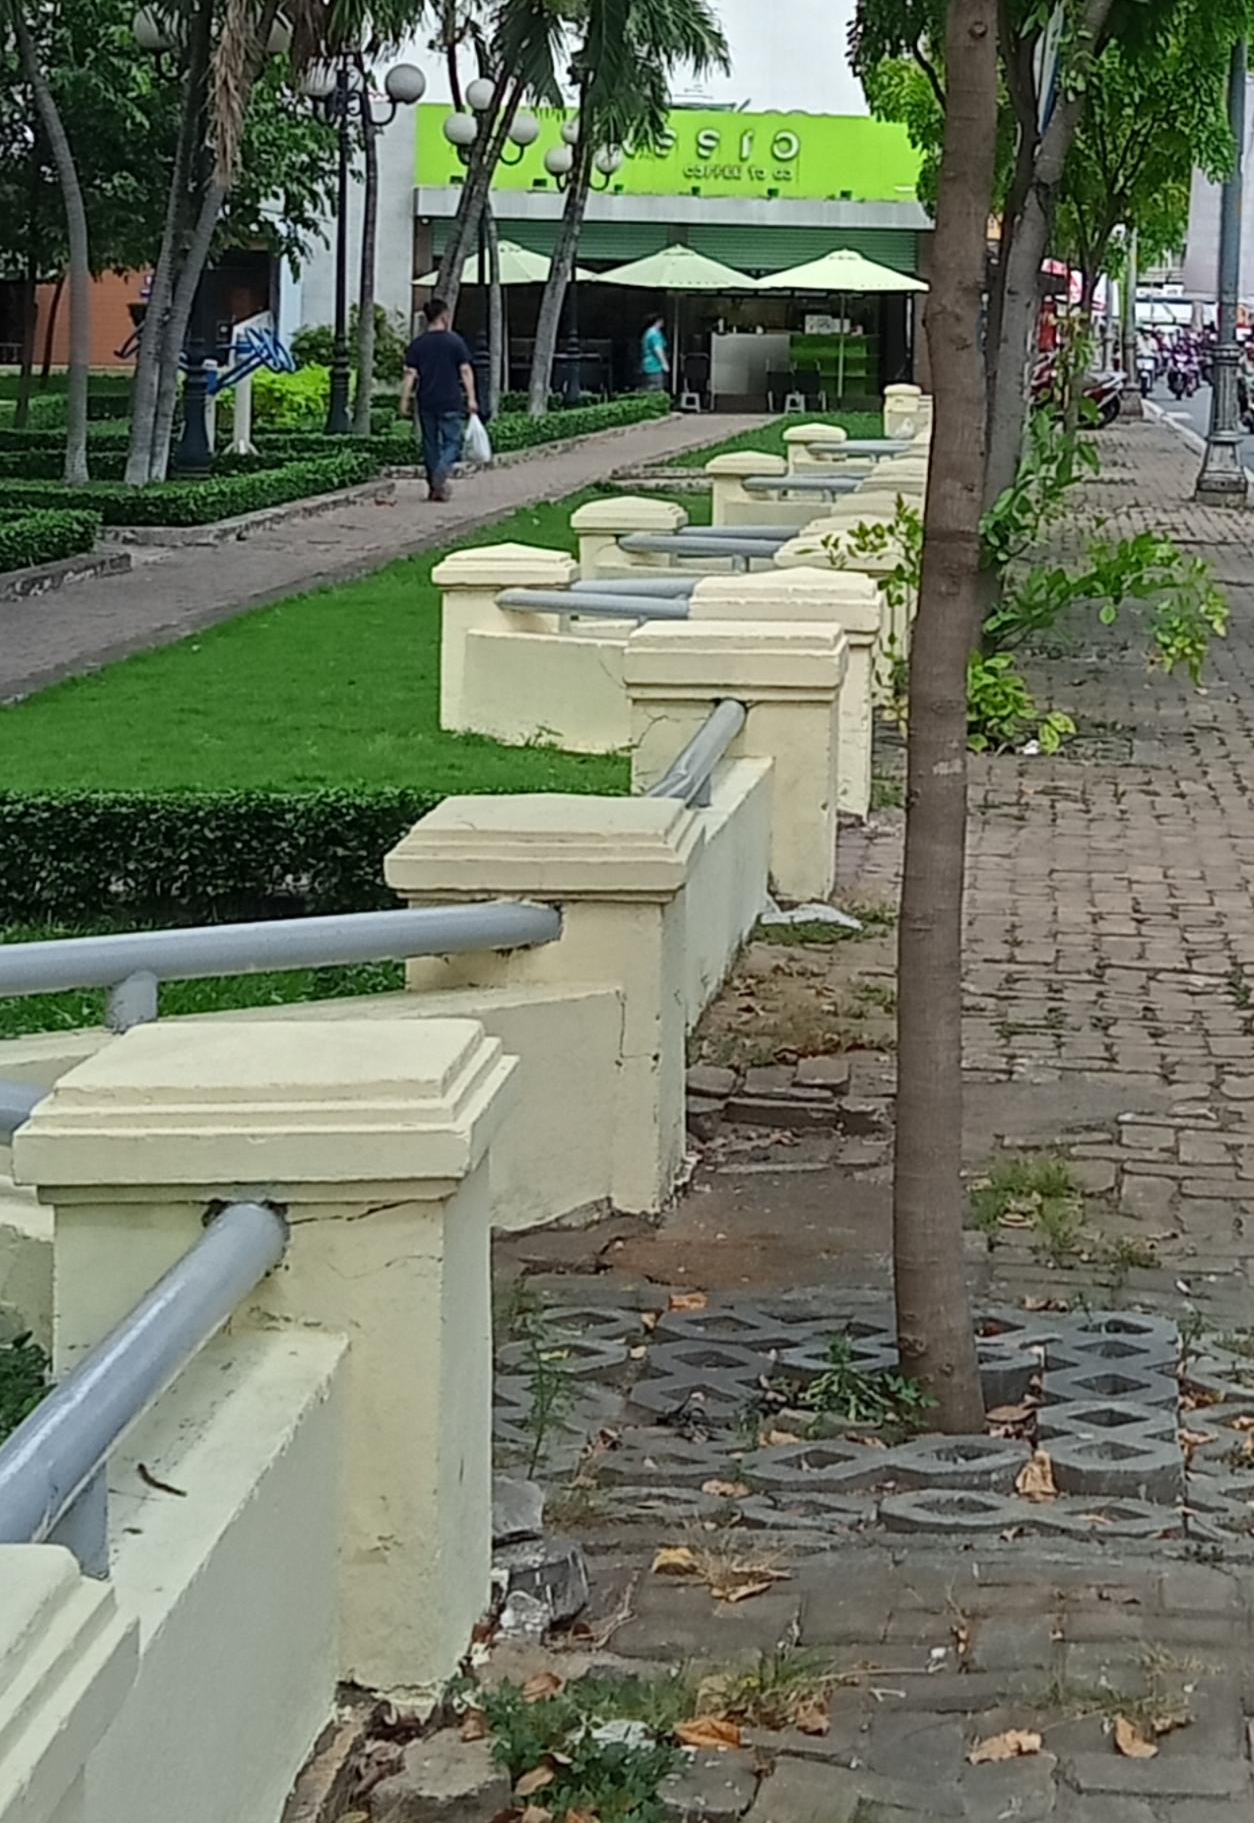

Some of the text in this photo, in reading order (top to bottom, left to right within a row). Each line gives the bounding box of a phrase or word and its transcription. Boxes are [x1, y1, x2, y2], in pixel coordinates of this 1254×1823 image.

[683, 165, 793, 181] COFFEE TO GO
